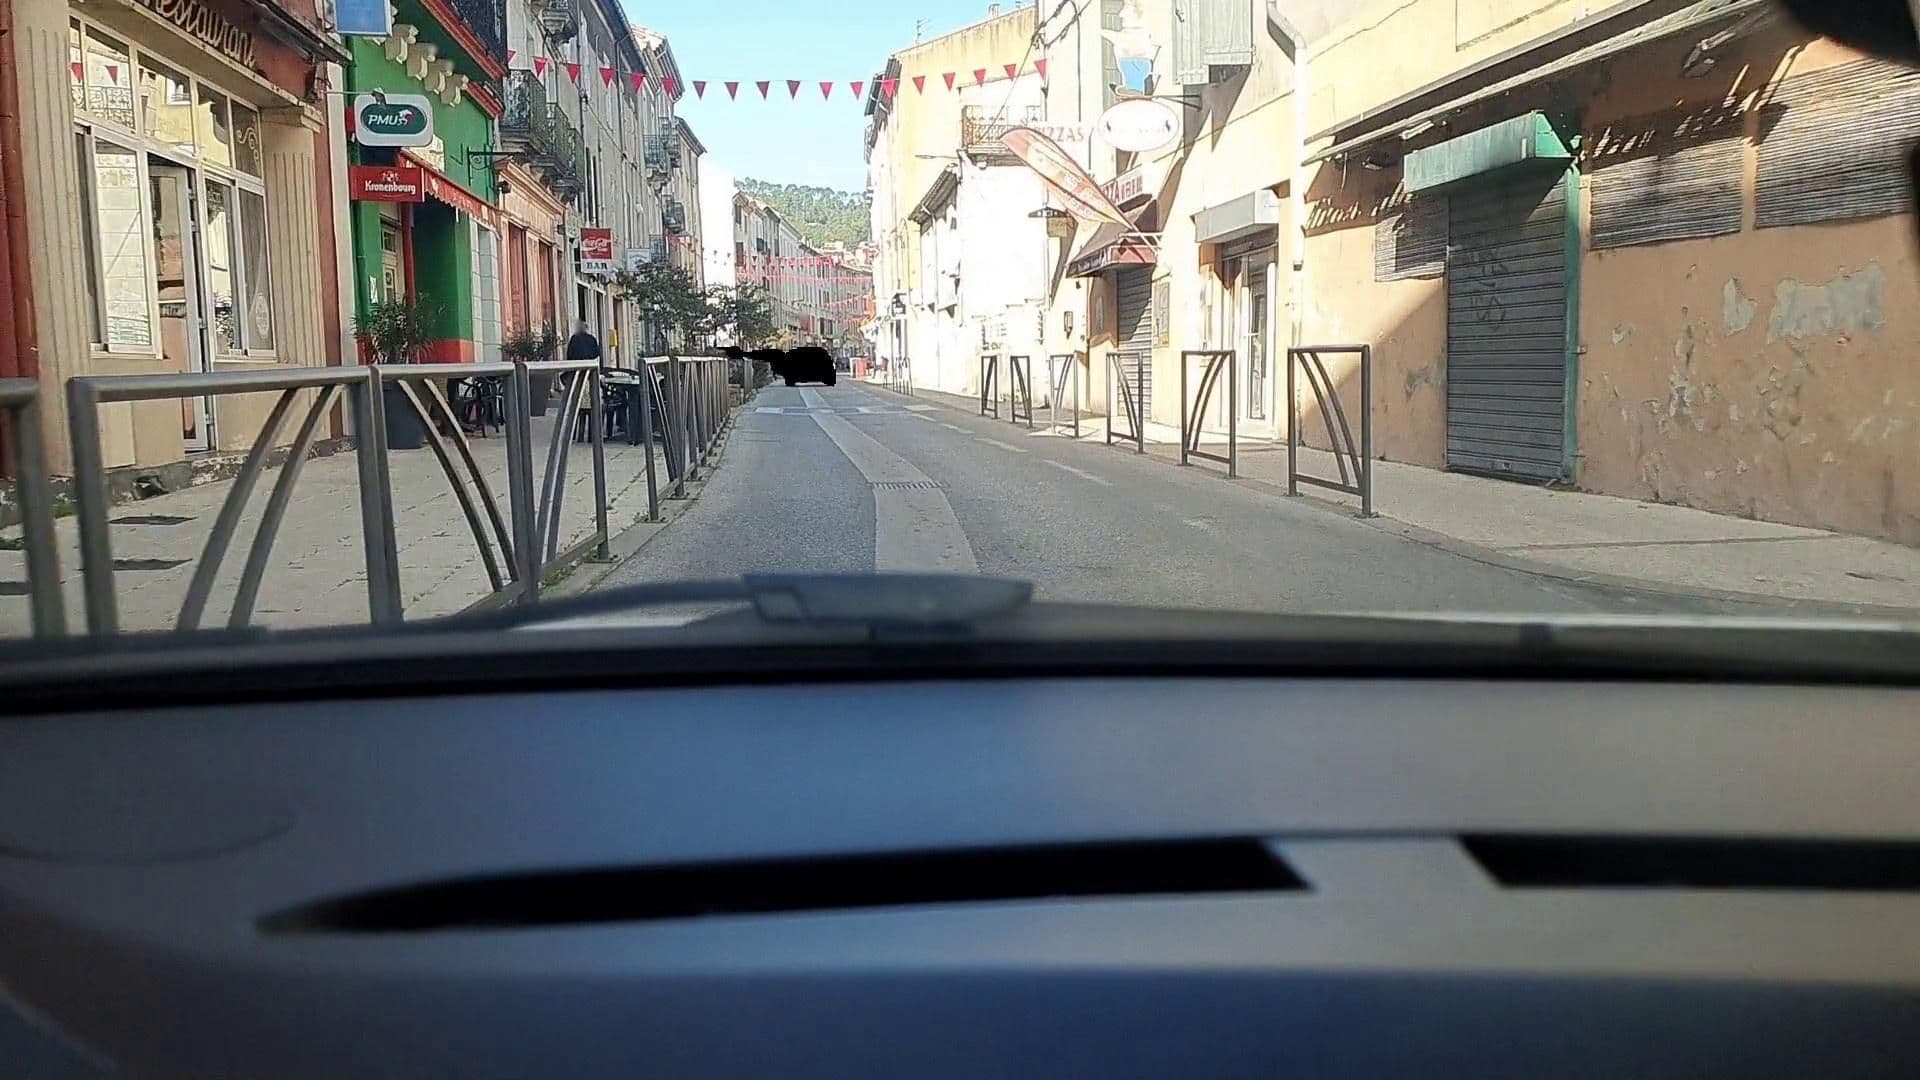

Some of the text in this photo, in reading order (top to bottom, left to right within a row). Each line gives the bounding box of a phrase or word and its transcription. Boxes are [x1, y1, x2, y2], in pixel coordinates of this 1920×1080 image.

[143, 0, 255, 68] estaurant
[368, 114, 399, 125] PMU
[1035, 126, 1084, 142] ZZAS
[364, 180, 416, 195] Kronenbourg
[586, 262, 608, 270] BAR
